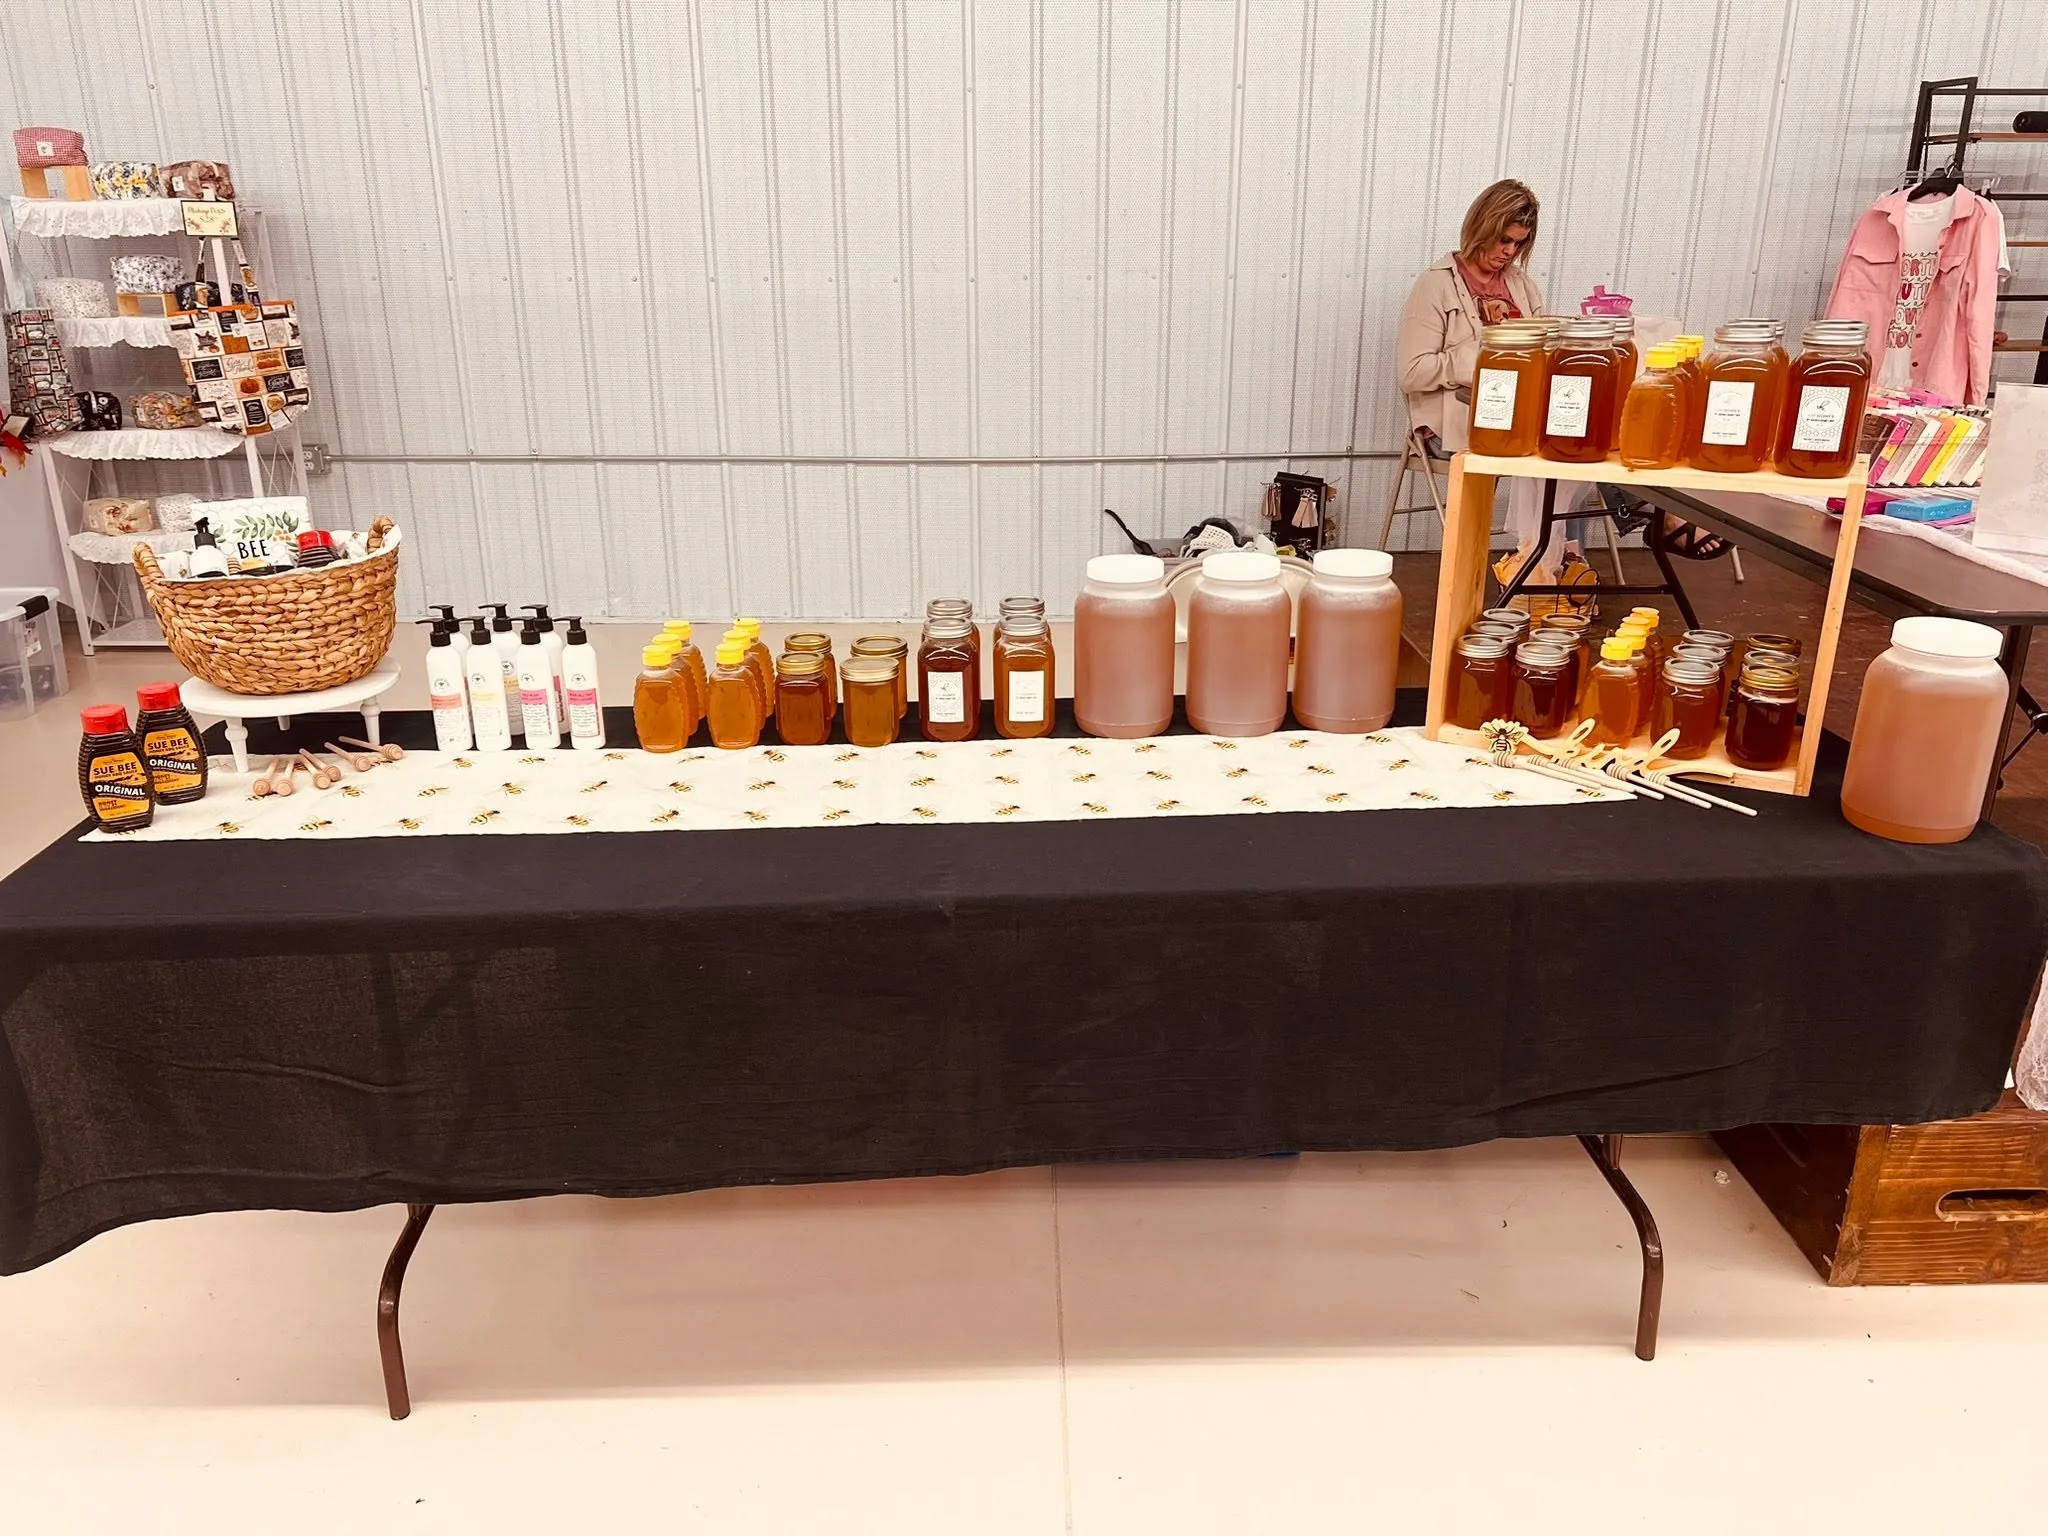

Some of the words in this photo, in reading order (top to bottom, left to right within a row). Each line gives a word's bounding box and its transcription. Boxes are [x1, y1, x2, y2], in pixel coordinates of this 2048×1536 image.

[237, 539, 270, 559] BEE
[148, 741, 167, 749] SUE
[170, 738, 188, 746] BEE
[93, 766, 114, 775] SUE
[118, 762, 137, 771] BEE
[150, 759, 197, 770] ORIGINAL
[95, 785, 145, 795] ORIGINAL
